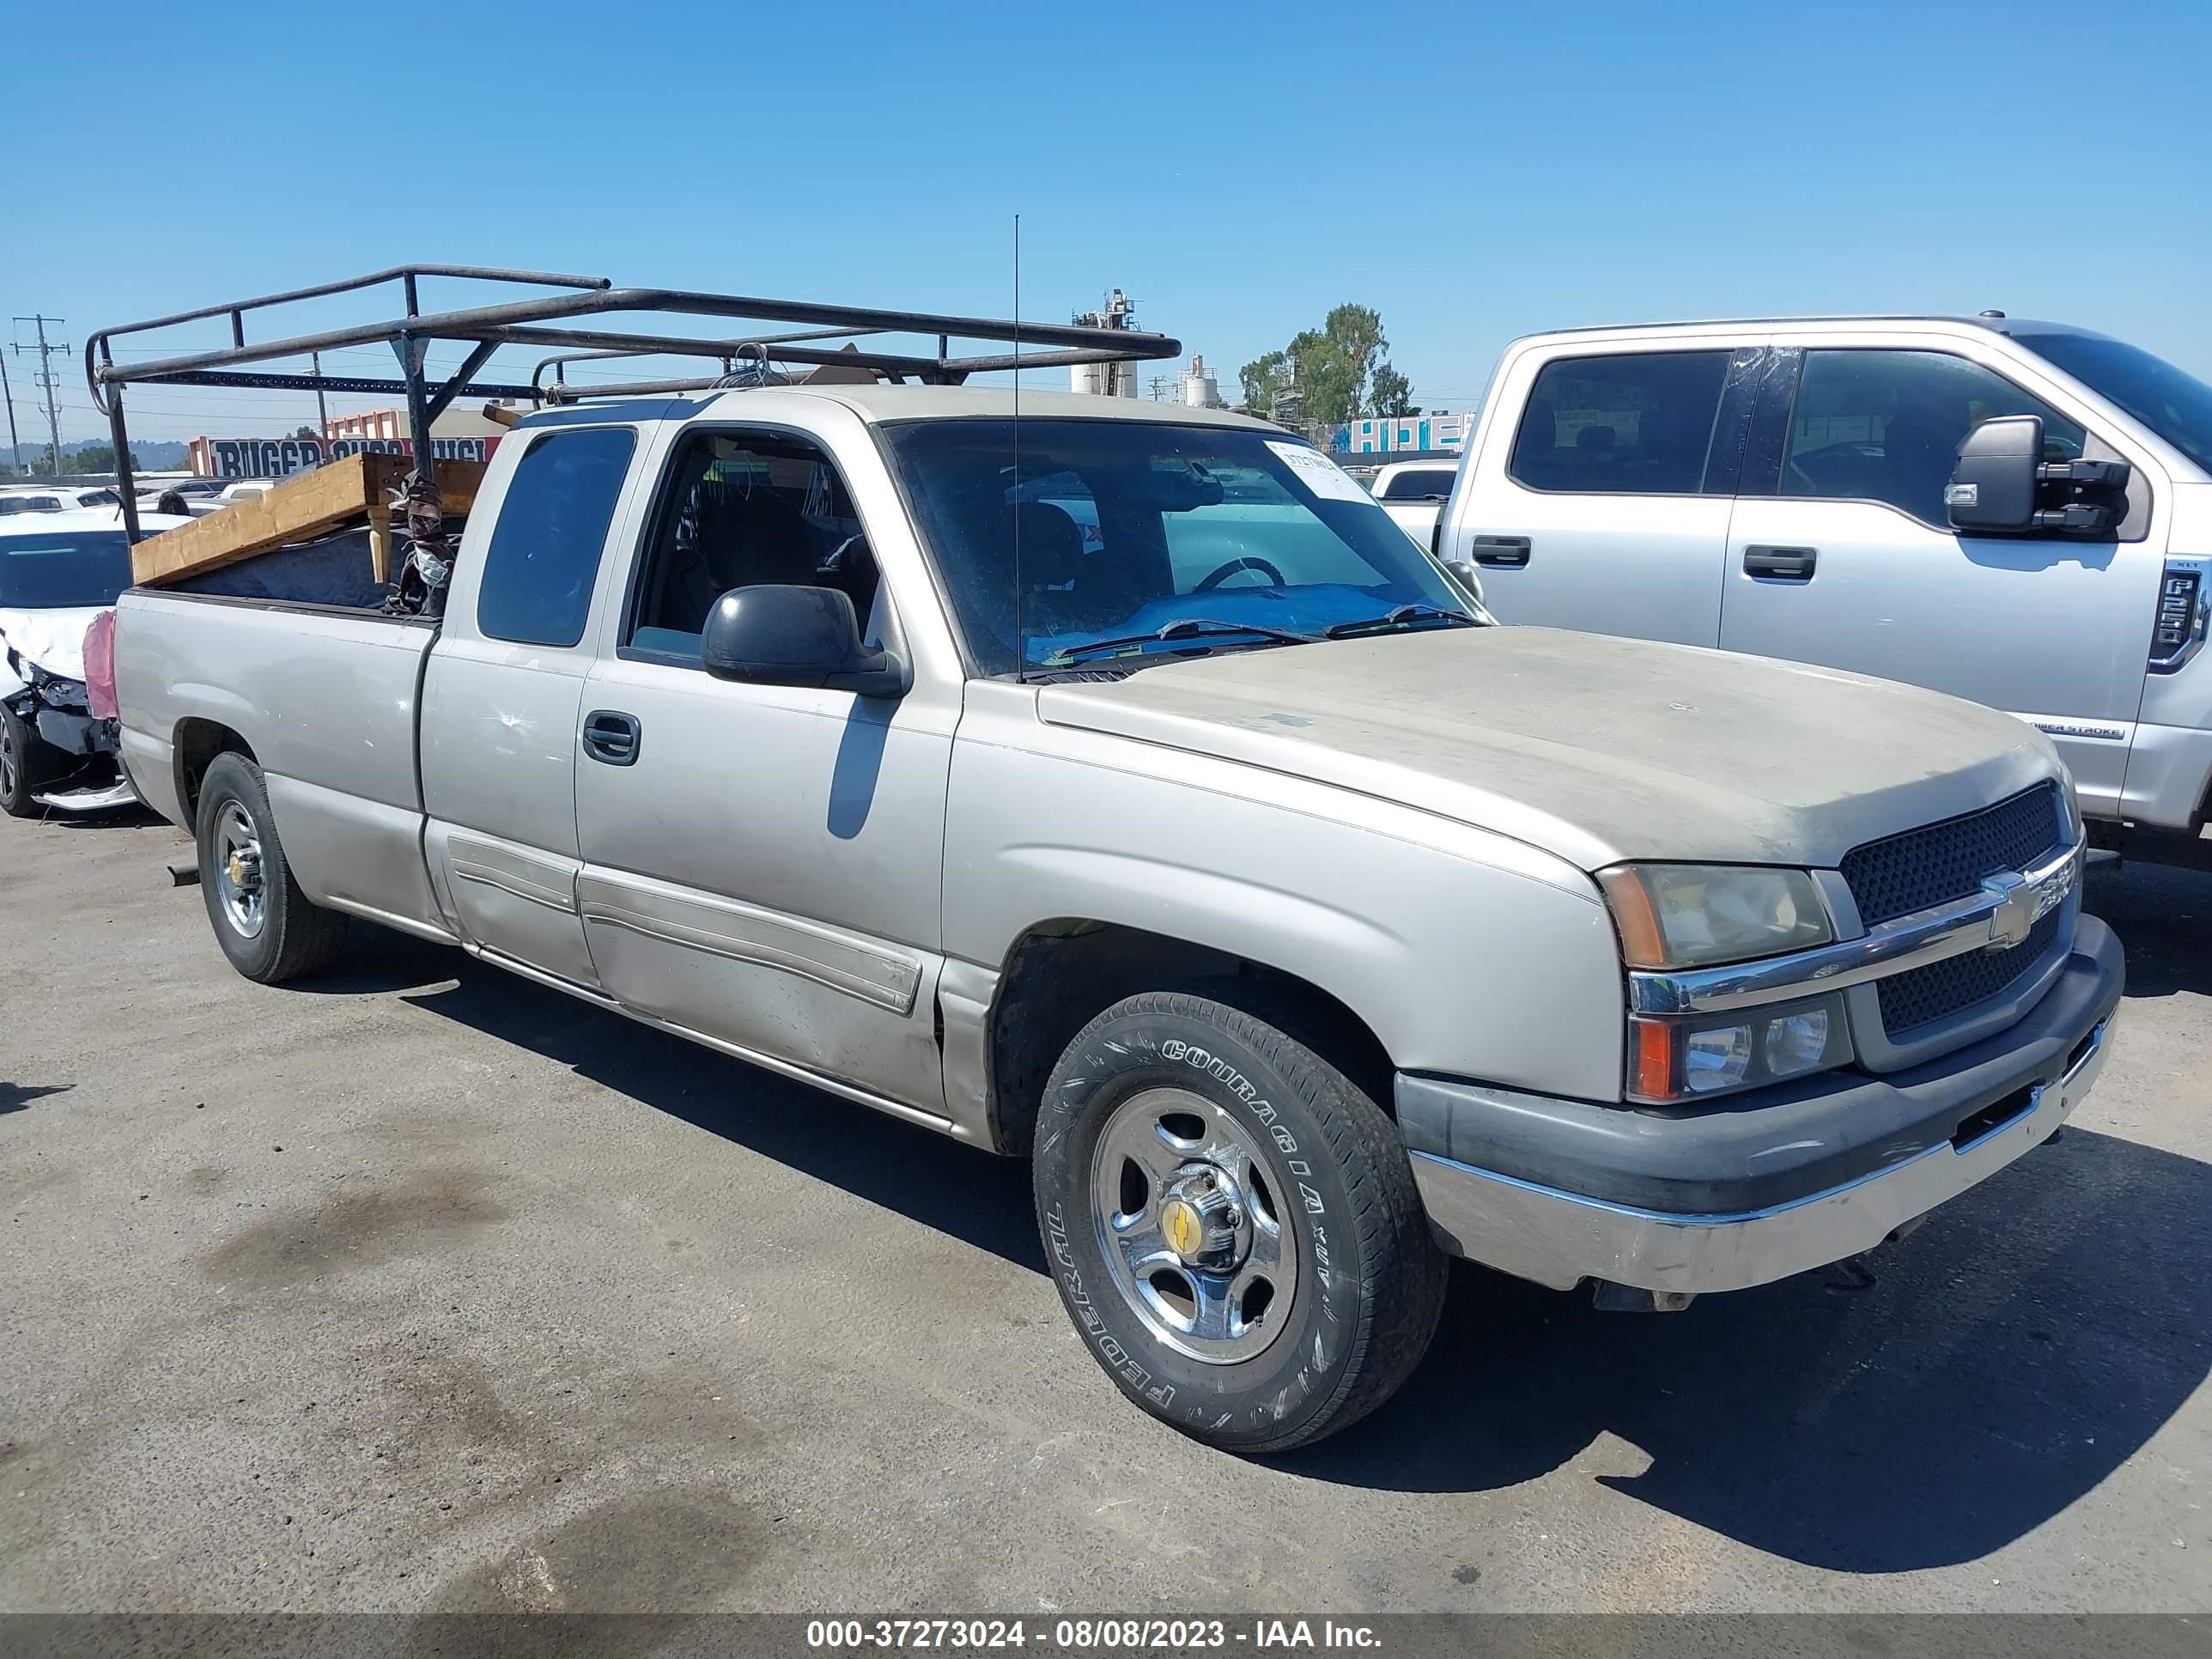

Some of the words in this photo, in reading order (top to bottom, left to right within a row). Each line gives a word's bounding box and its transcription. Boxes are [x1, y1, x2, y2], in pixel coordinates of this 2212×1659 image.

[2029, 721, 2065, 732] OWER
[2067, 726, 2121, 736] STROKE
[1161, 1039, 1326, 1214] COURAGIA
[1046, 1201, 1176, 1409] FEDERAL
